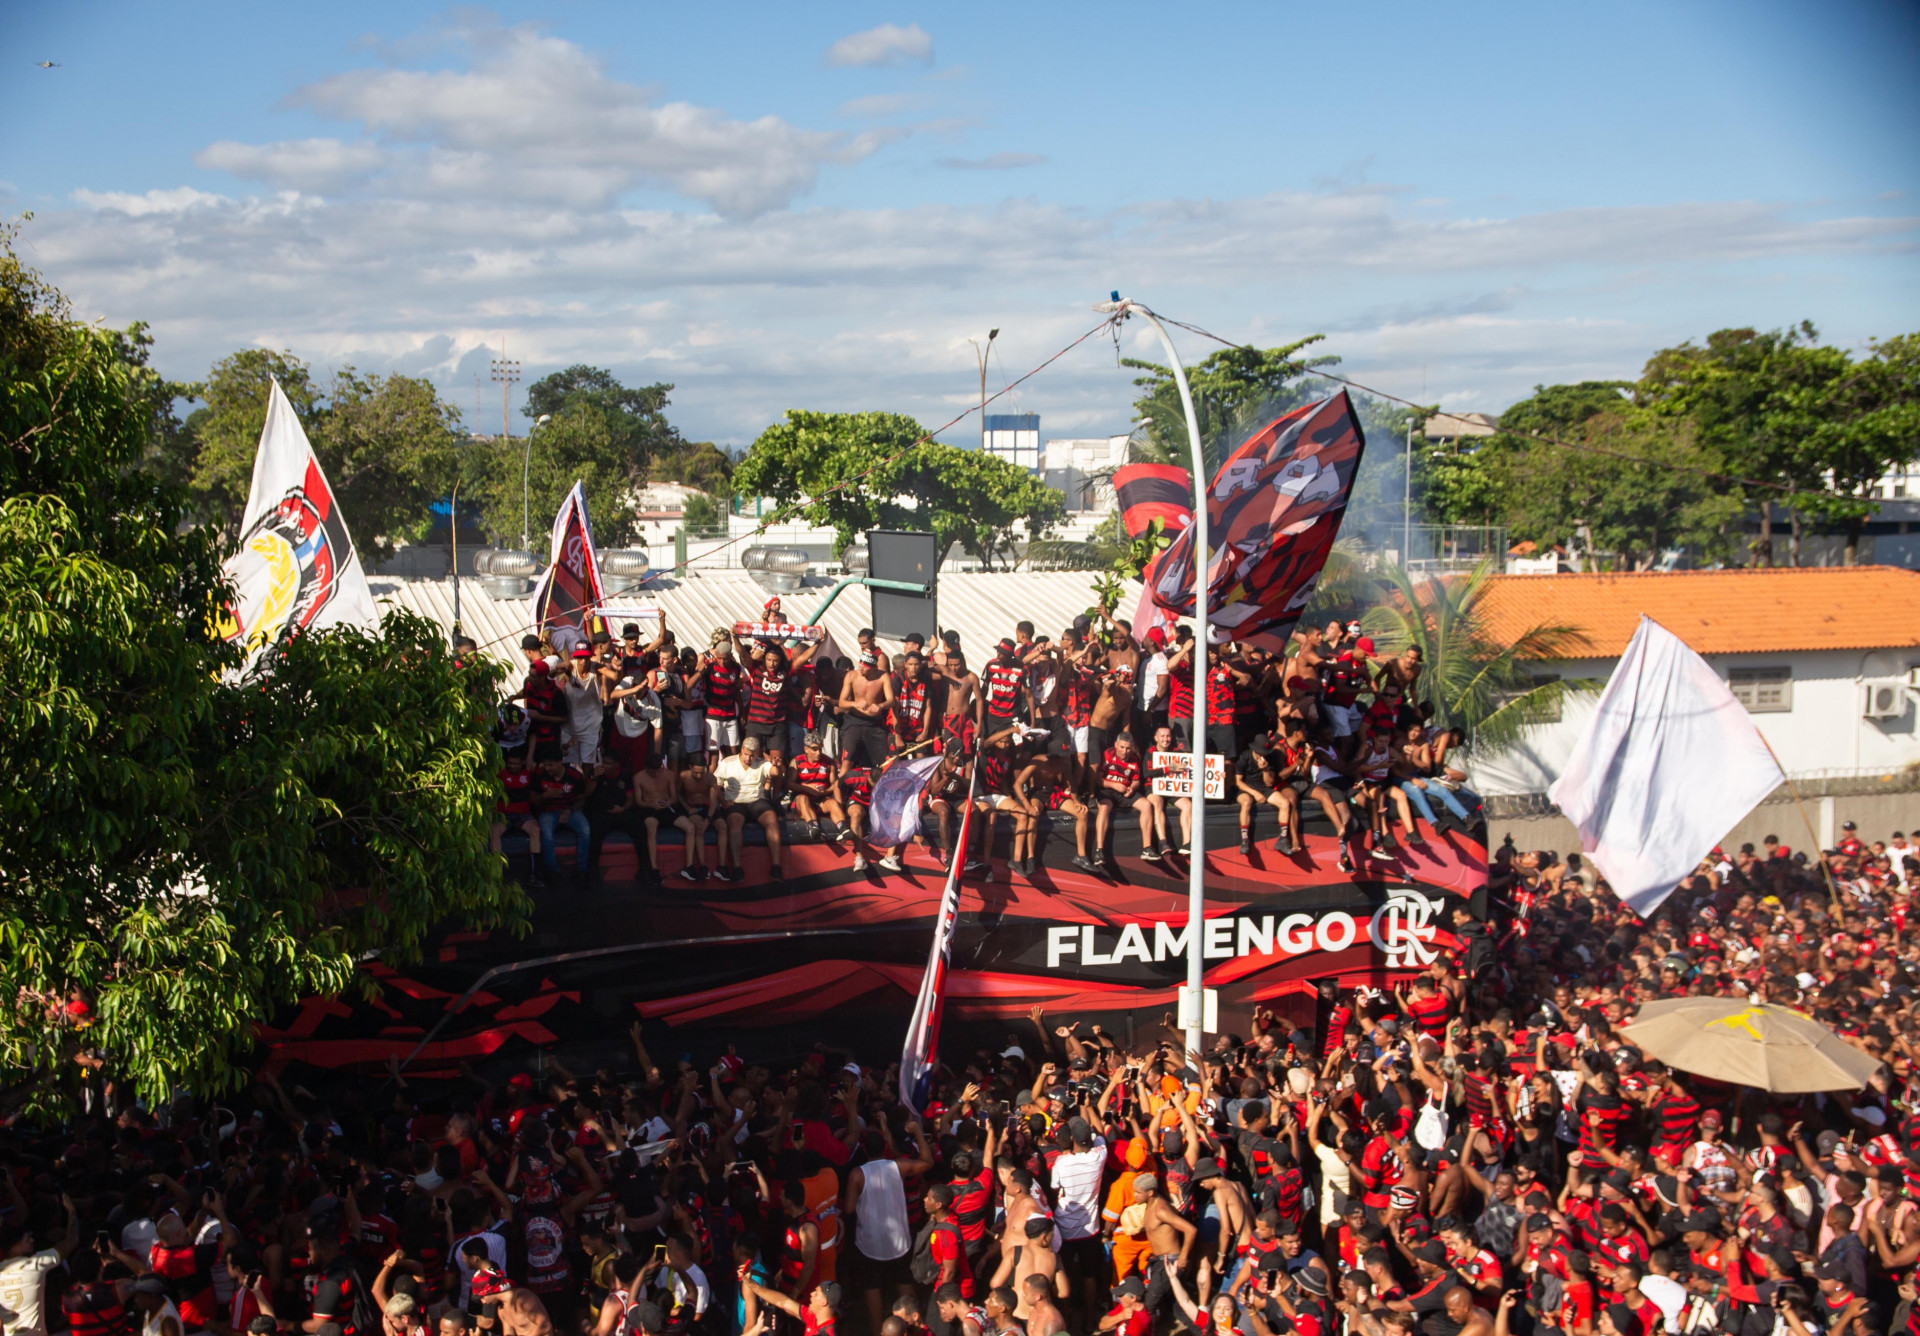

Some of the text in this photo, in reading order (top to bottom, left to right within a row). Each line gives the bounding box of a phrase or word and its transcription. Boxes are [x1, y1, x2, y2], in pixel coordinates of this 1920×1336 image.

[751, 622, 805, 637] RAÇA
[1162, 769, 1221, 782] ORREOS
[1047, 911, 1356, 968] FLAMENGO
